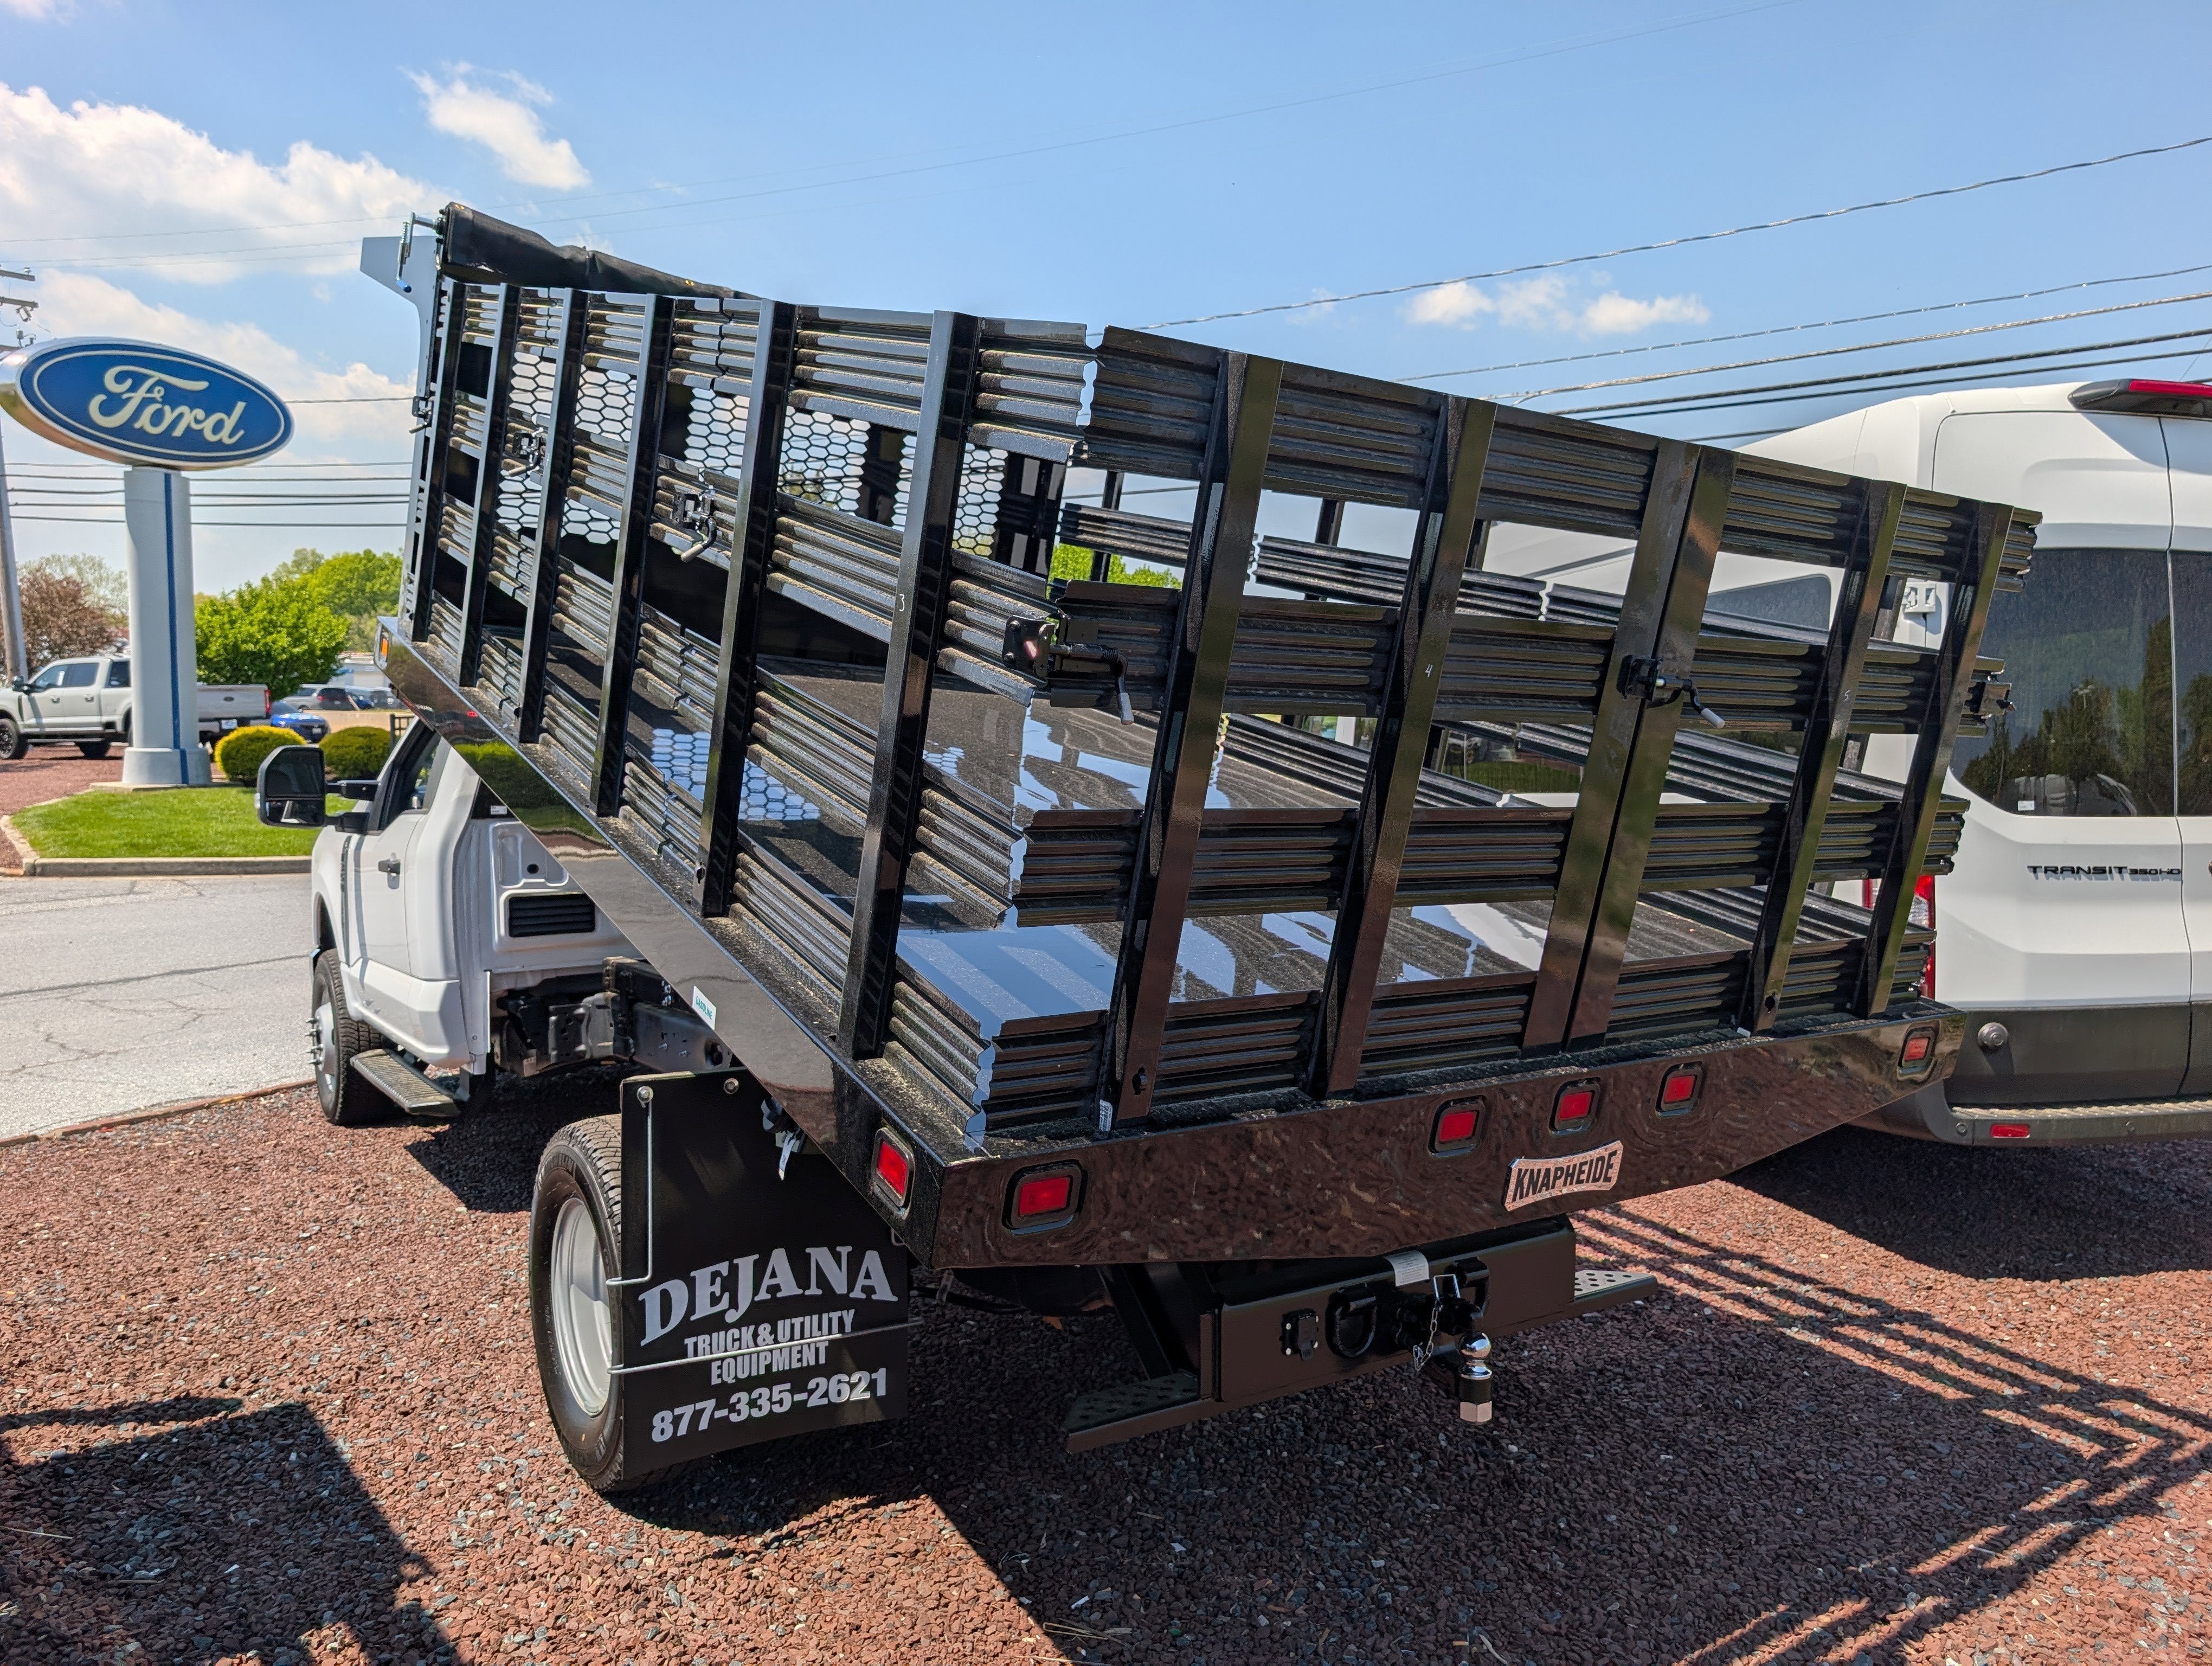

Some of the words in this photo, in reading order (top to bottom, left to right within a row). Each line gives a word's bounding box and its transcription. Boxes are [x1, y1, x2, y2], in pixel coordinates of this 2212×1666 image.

[88, 364, 246, 445] Ford
[899, 593, 905, 612] 3
[1425, 664, 1433, 678] 4
[2027, 866, 2127, 875] TRANSIT
[696, 996, 713, 1020] GASOLINE
[1511, 1150, 1618, 1202] KNAPHEIDE
[638, 1245, 898, 1347] DEJANA
[684, 1323, 755, 1358] TRUCK
[776, 1308, 856, 1341] UTILITY
[711, 1341, 829, 1386] EQUIPMENT
[652, 1367, 887, 1443] 877-335-2621
